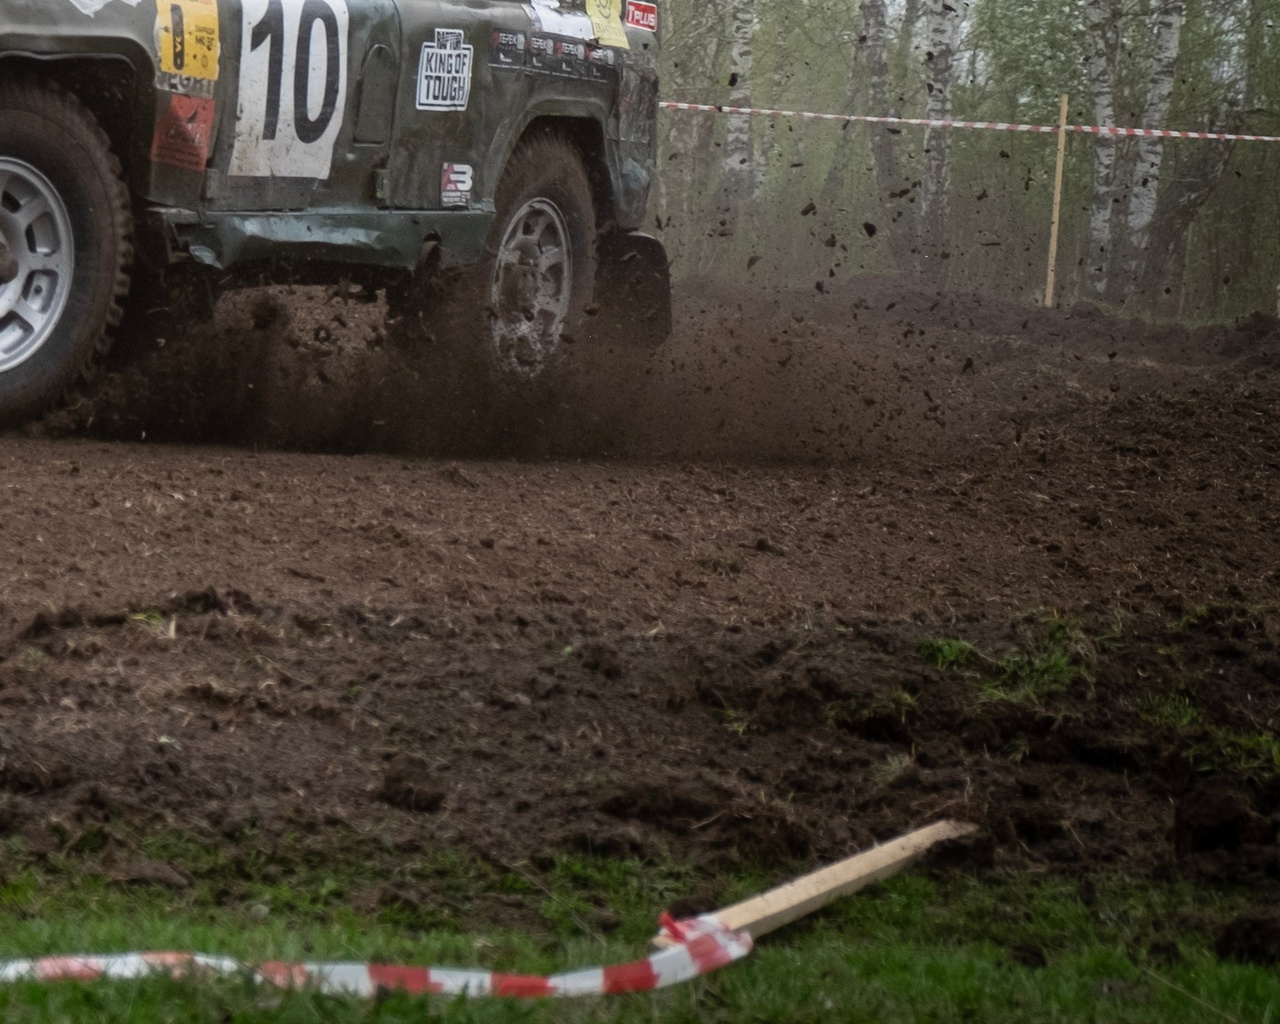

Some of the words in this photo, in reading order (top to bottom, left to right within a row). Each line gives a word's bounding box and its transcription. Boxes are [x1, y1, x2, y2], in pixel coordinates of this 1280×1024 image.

[425, 51, 453, 74] KING
[455, 53, 467, 75] OF
[424, 75, 466, 102] TOUGH
